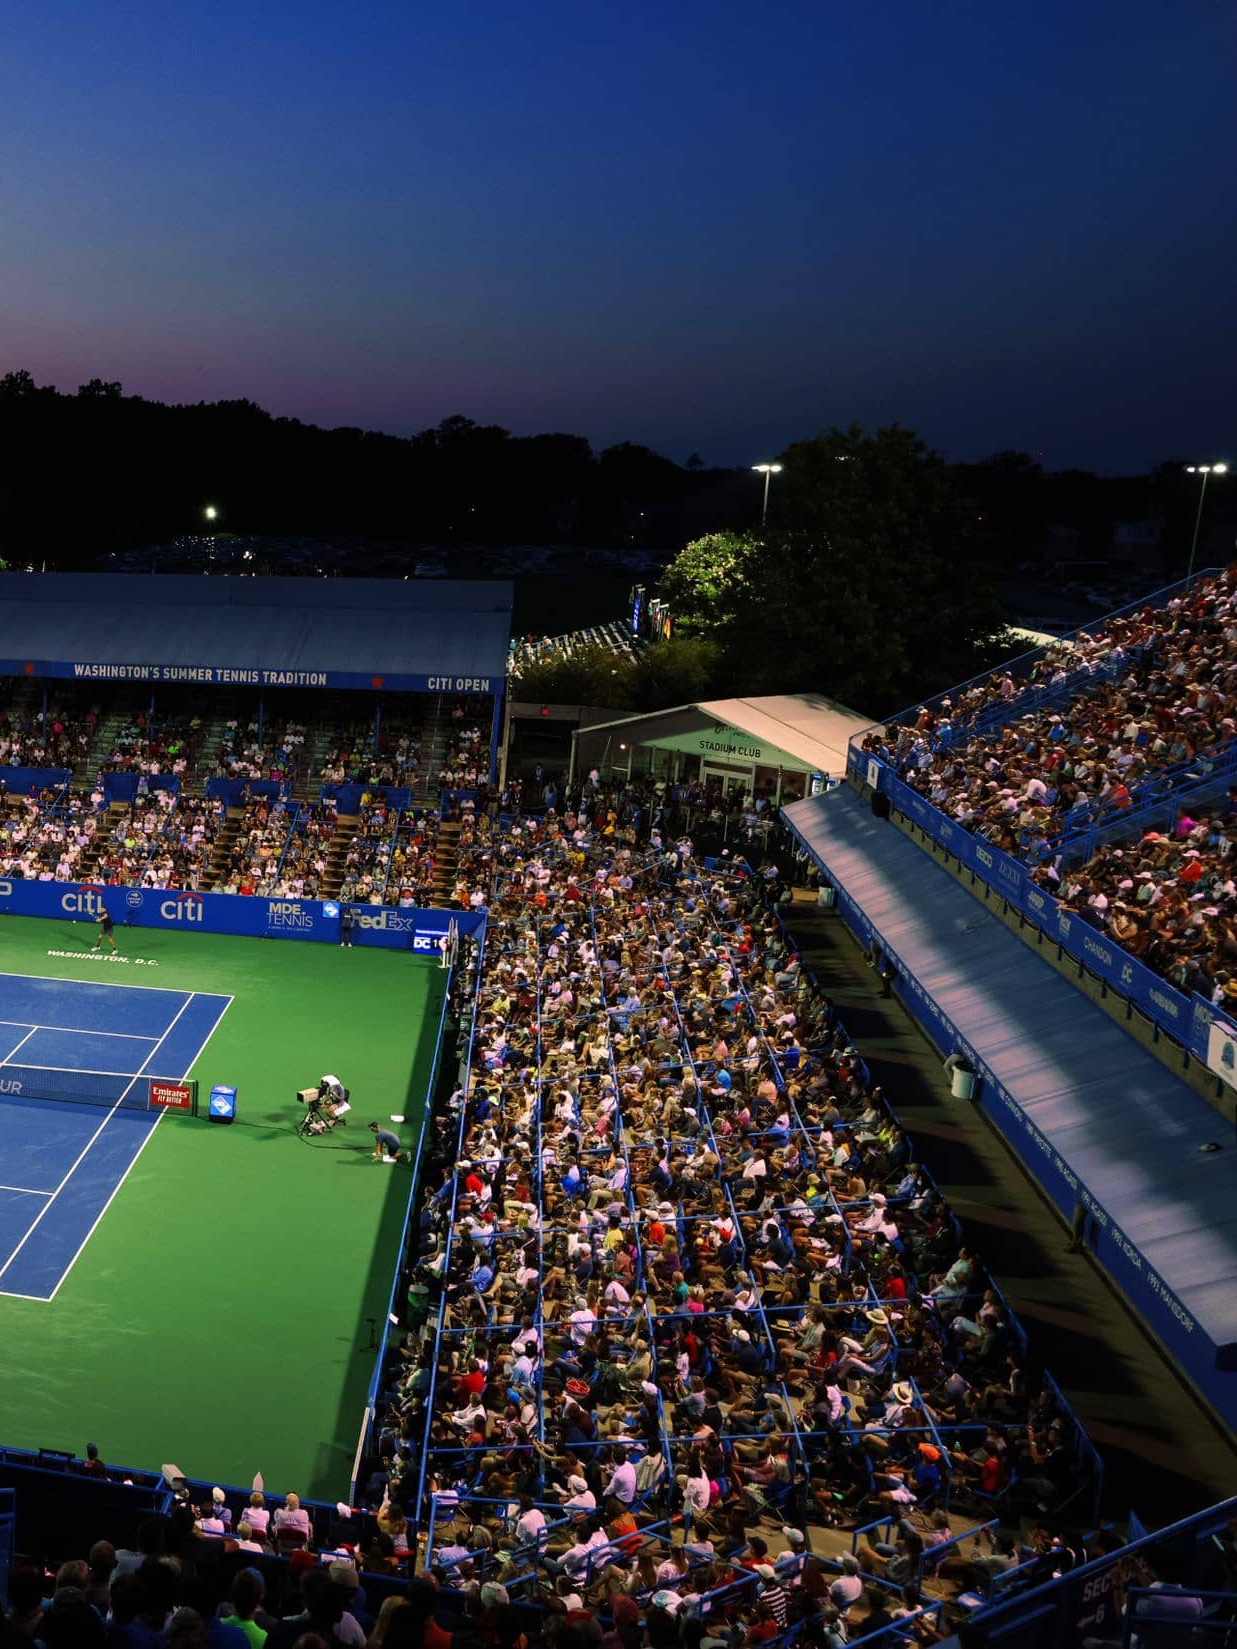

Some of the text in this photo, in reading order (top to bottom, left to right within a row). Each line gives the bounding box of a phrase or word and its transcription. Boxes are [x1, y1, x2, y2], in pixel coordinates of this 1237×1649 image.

[74, 664, 327, 686] WASHINGTON'S SUMMER TENNIS TRADITION
[427, 677, 490, 692] CITI OPEN
[699, 740, 761, 758] STADIUM CLUB
[61, 887, 102, 914] citi
[160, 894, 203, 922] citi
[266, 912, 314, 928] TENNIS
[349, 908, 413, 931] FedEx
[413, 936, 431, 949] DC
[47, 950, 160, 966] WASHINGTON, D.C.
[152, 1086, 188, 1098] Emirates
